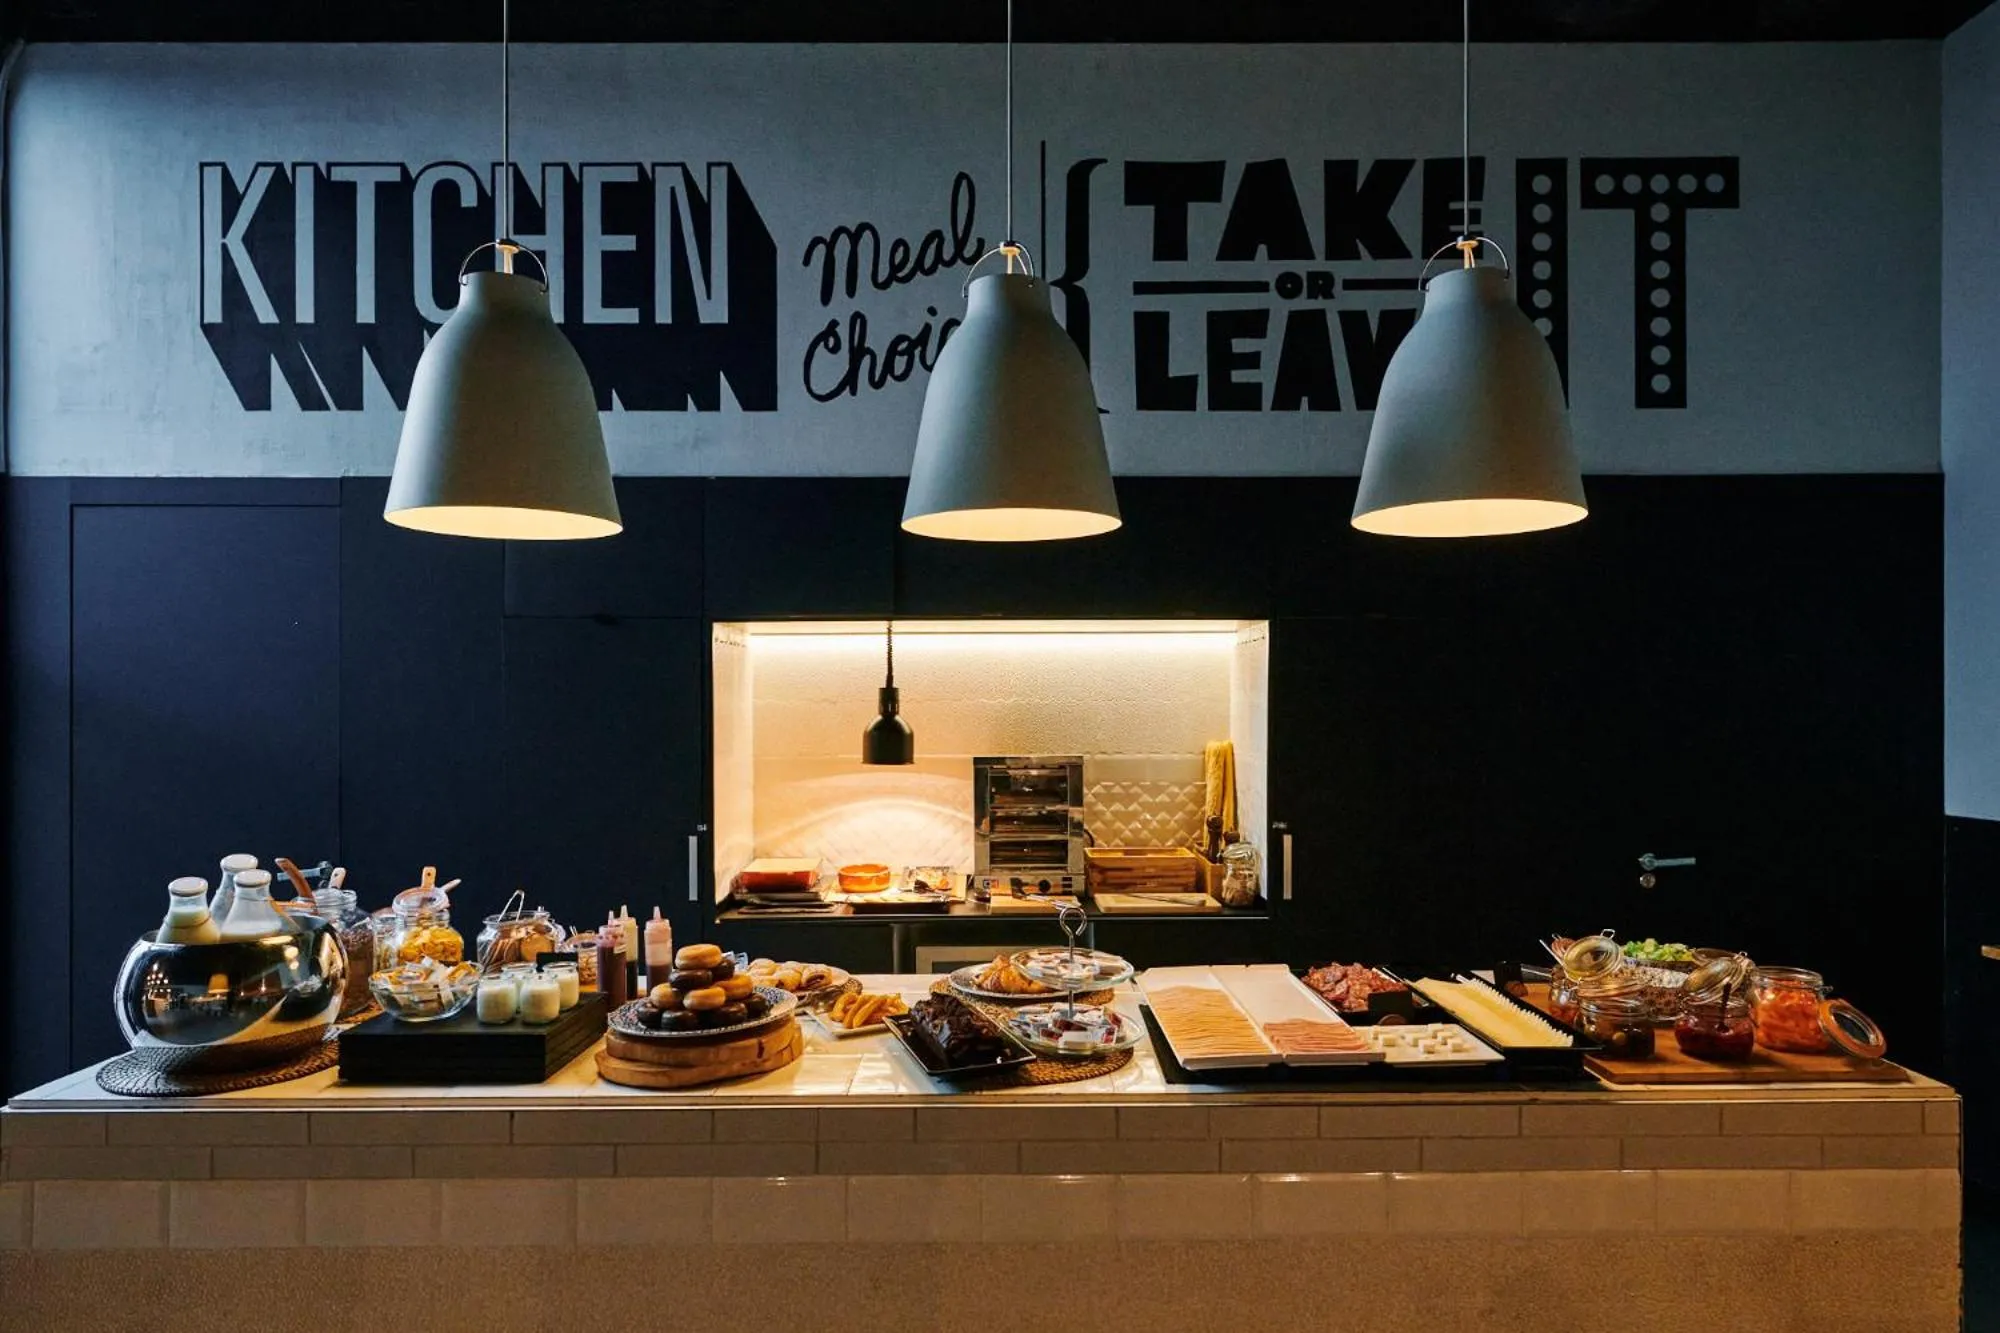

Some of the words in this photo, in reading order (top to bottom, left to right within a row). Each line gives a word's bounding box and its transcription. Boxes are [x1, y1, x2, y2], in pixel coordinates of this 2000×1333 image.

[199, 162, 733, 324] KITCHEN
[803, 171, 985, 306] Meal
[1124, 156, 1485, 262] TAKE
[1275, 271, 1335, 300] OR
[1516, 157, 1739, 408] IT
[803, 306, 962, 402] Choic
[1134, 308, 1417, 412] LEAV
